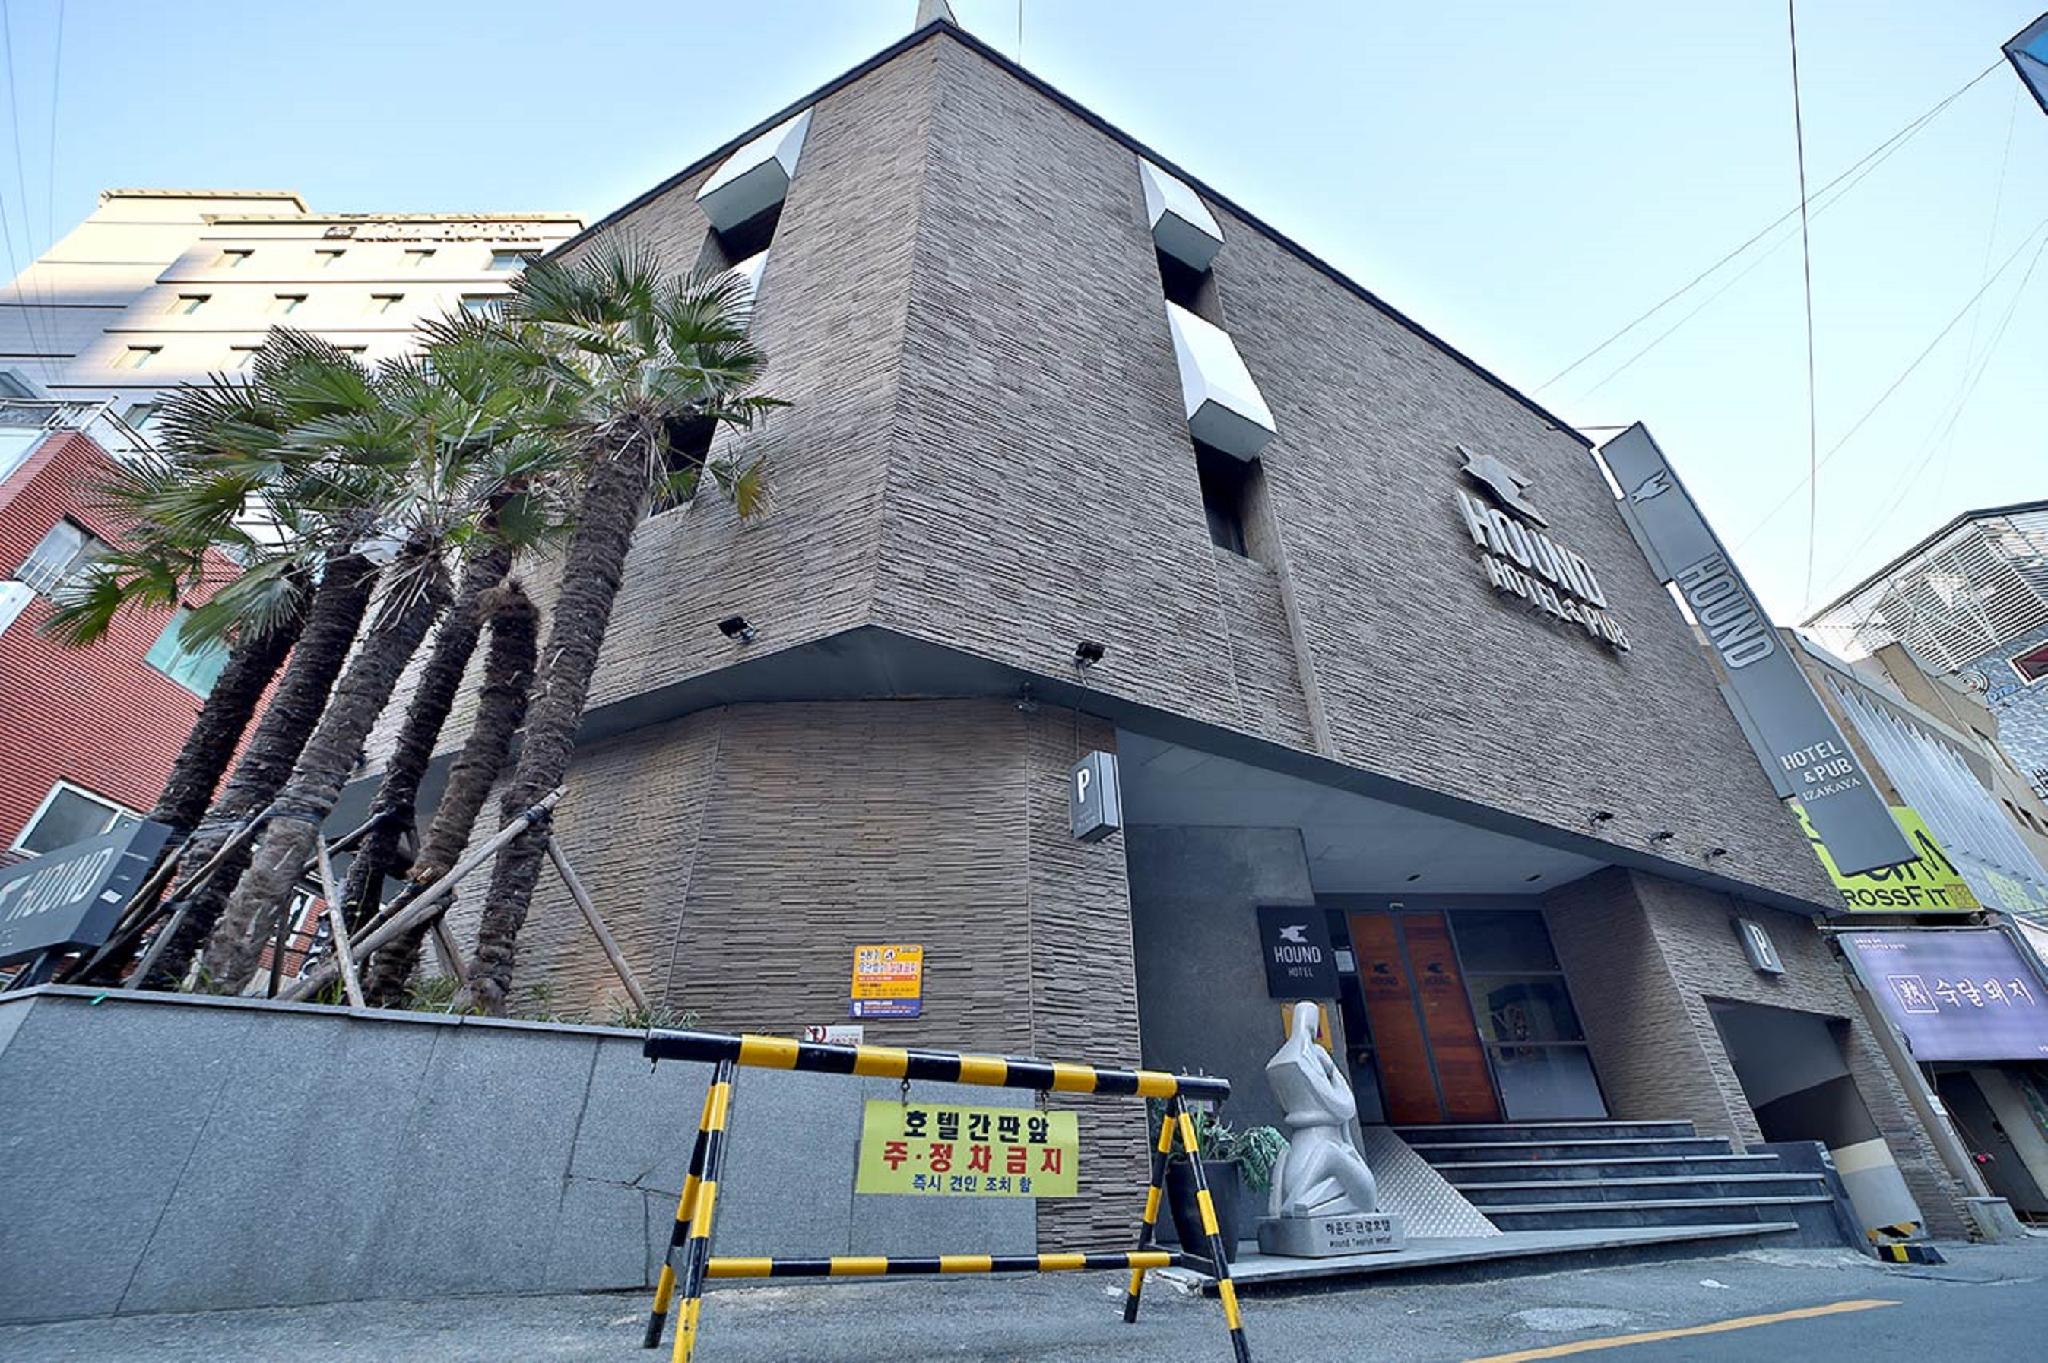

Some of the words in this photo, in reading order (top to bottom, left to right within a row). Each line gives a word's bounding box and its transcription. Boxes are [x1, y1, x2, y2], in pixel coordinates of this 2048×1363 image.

[1457, 488, 1607, 610] HOUND
[1676, 551, 1774, 669] HOUND
[1780, 740, 1842, 770] HOTEL
[1077, 768, 1091, 804] P
[1802, 777, 1861, 801] IZAKAYA
[5, 847, 114, 921] HOUND
[1274, 945, 1322, 963] HOUND
[1748, 924, 1772, 965] P
[1287, 966, 1314, 978] HOTEL
[912, 1173, 941, 1191] 즉시
[949, 1175, 977, 1192] 견인
[984, 1176, 1012, 1193] 조치
[1018, 1177, 1032, 1193] 함
